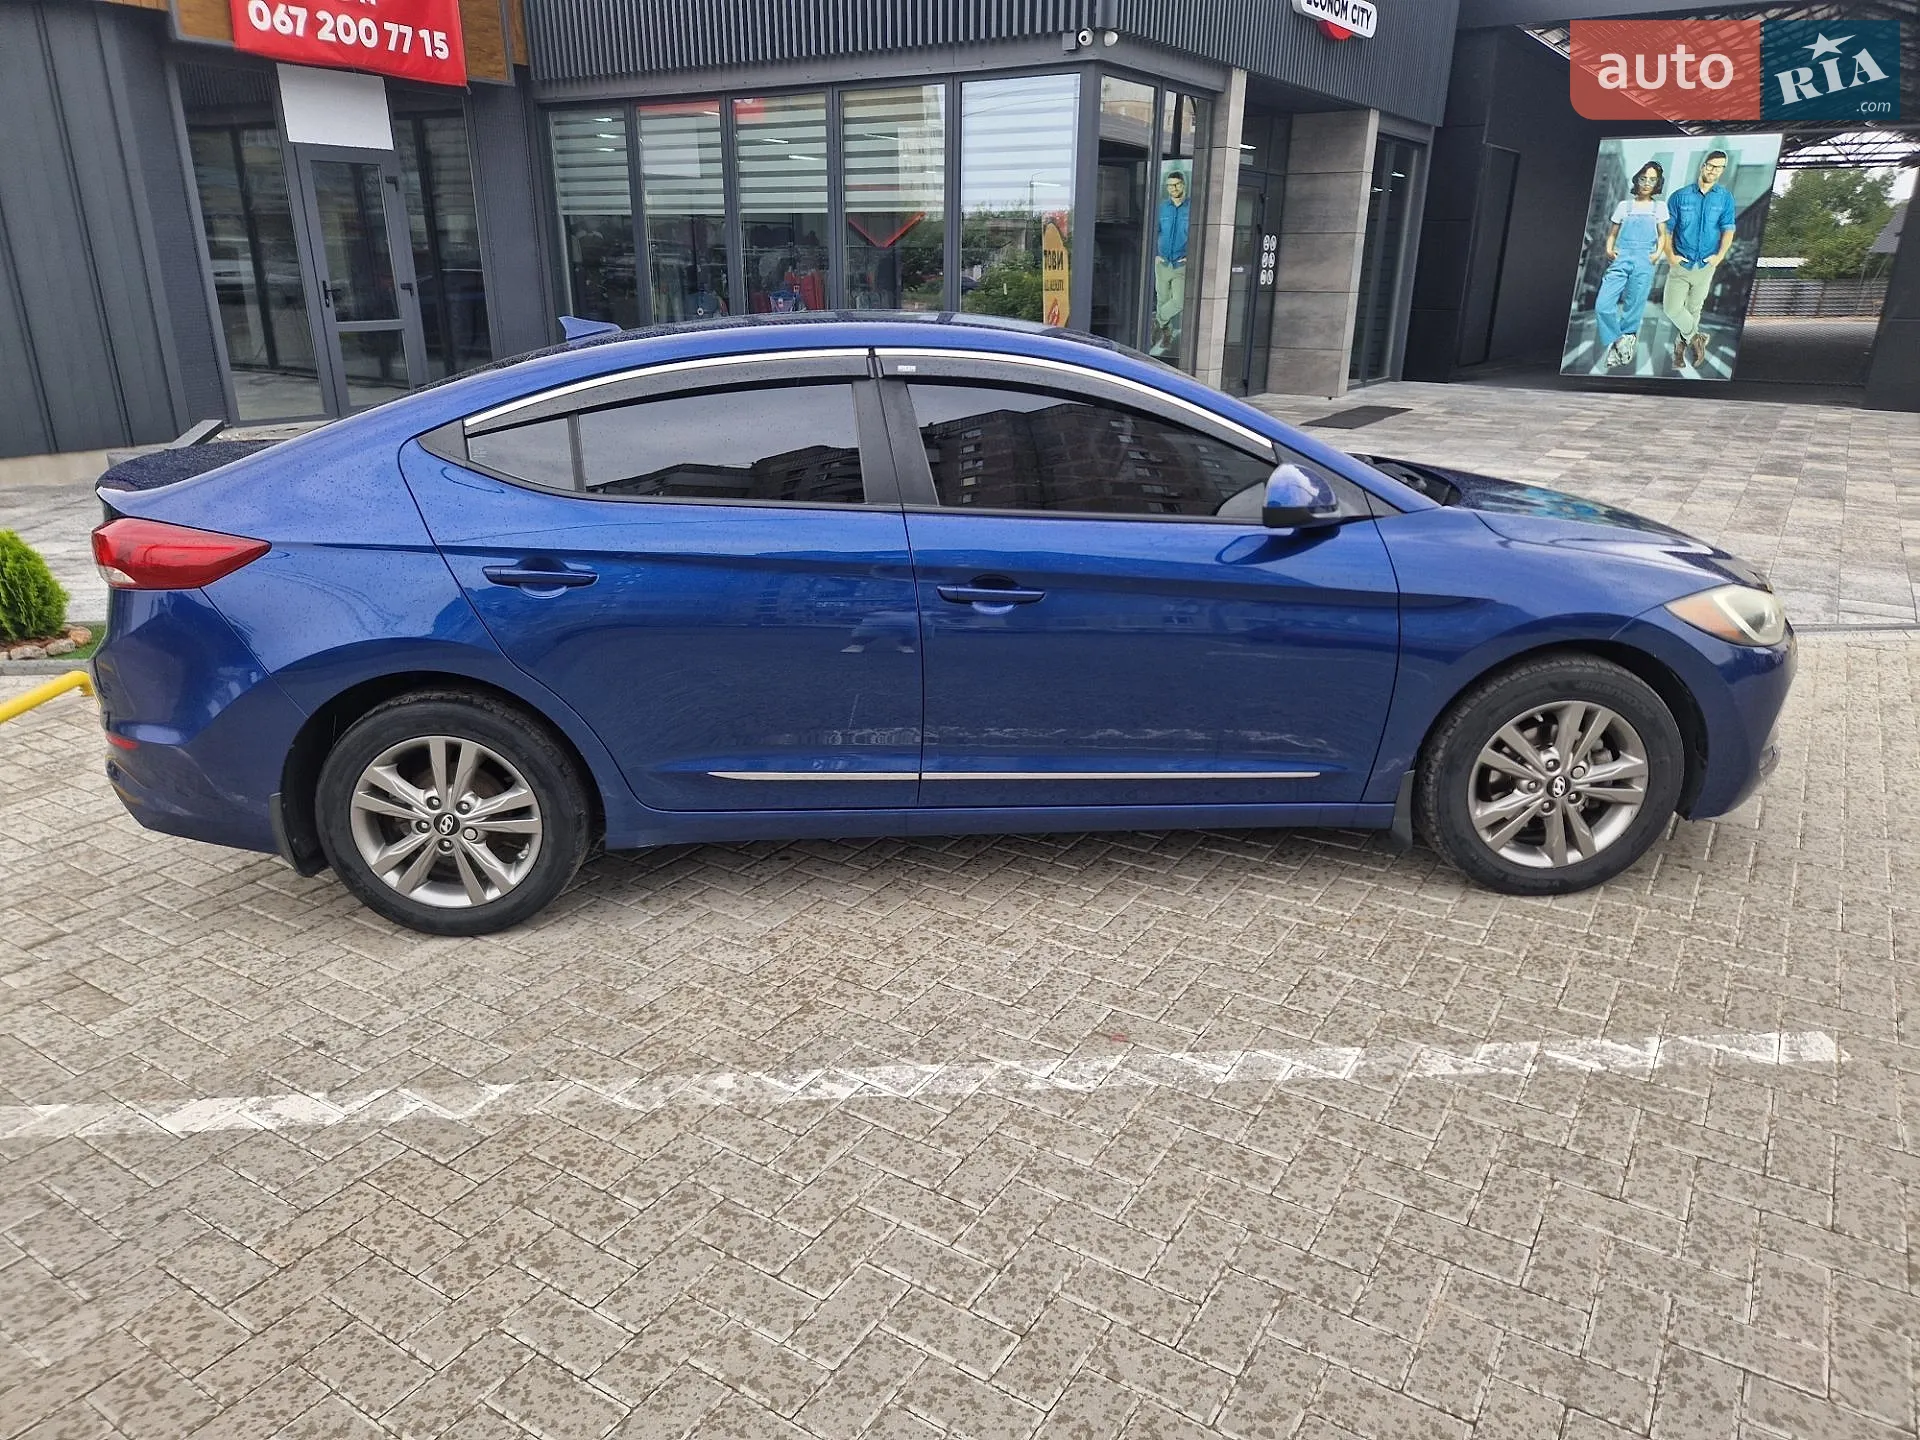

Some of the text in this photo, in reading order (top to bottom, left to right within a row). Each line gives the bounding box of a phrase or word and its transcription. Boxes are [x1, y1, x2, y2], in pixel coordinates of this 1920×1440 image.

[248, 0, 449, 60] 067 200 77 15
[1306, 0, 1372, 30] ONOM CITY
